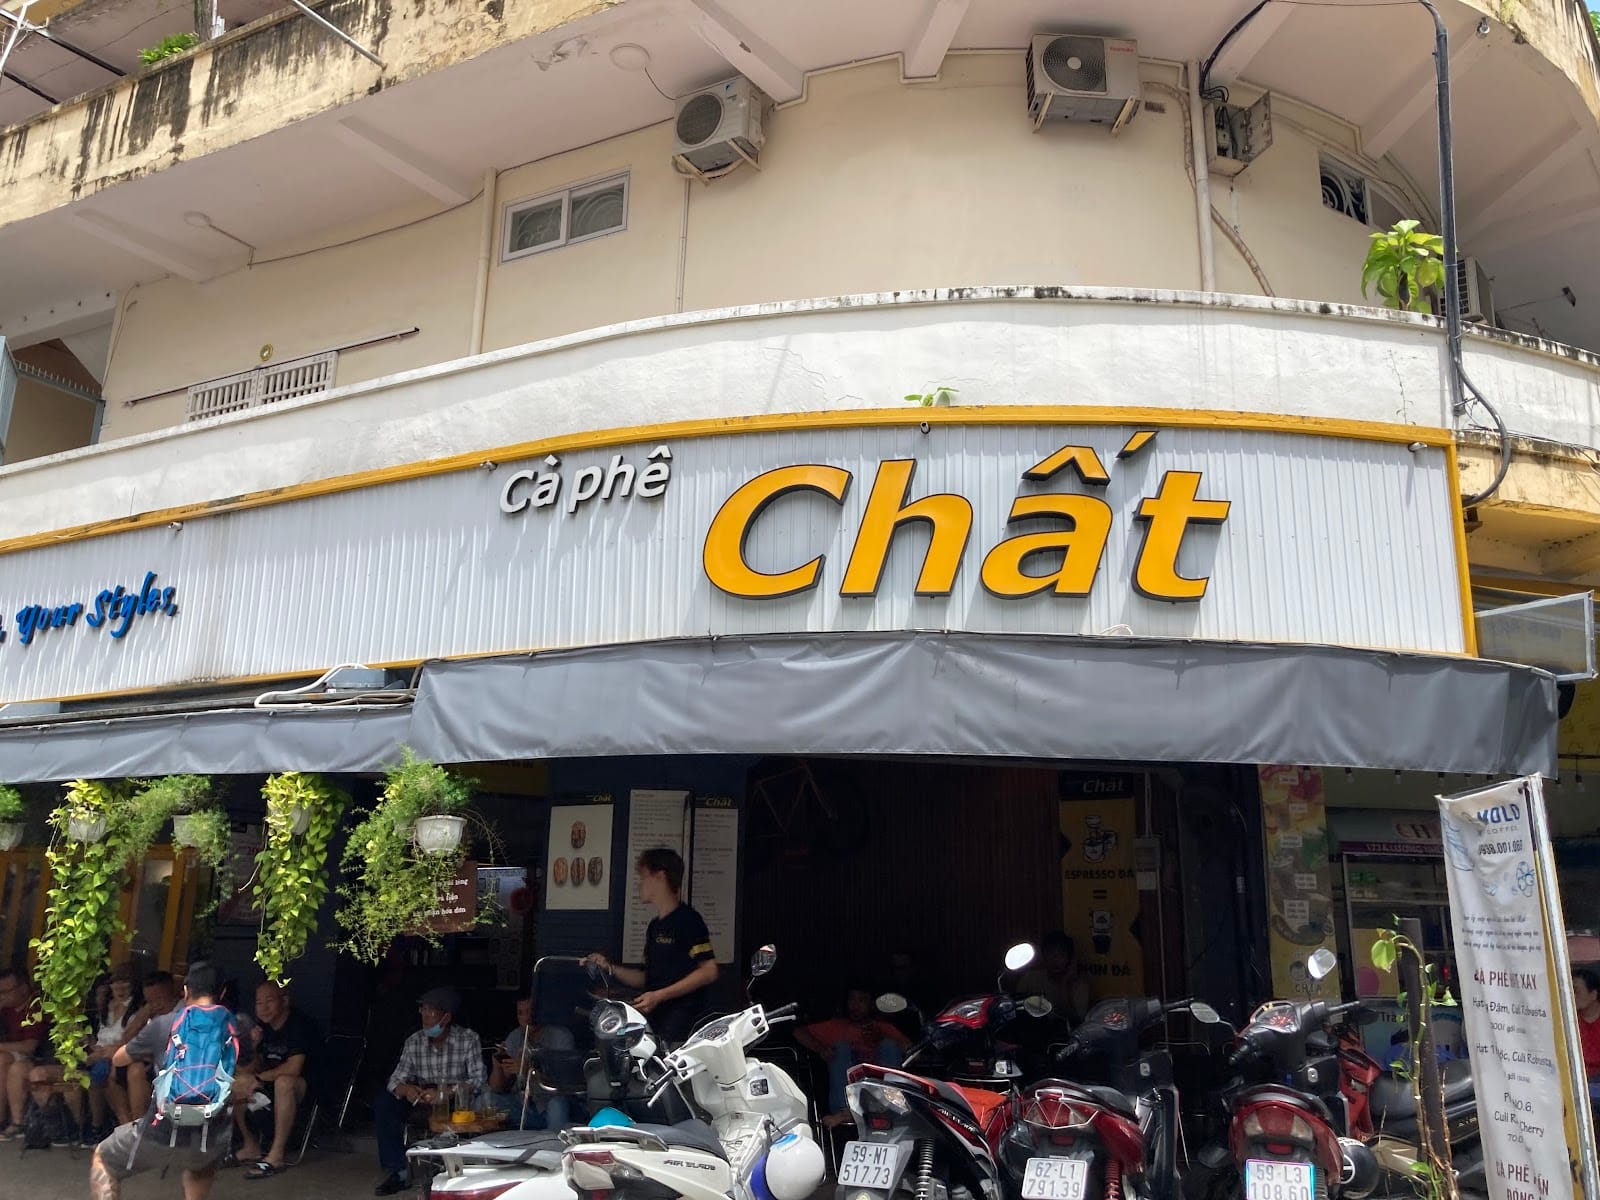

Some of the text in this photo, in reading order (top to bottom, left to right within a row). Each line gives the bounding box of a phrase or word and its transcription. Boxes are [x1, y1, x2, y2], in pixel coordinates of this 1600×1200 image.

[500, 445, 672, 513] Cà phê
[702, 431, 1231, 601] Chất
[1064, 870, 1116, 880] ESPRESSO
[1520, 972, 1538, 990] XAY
[842, 1164, 891, 1185] 517.73
[1027, 1179, 1080, 1198] 791.39
